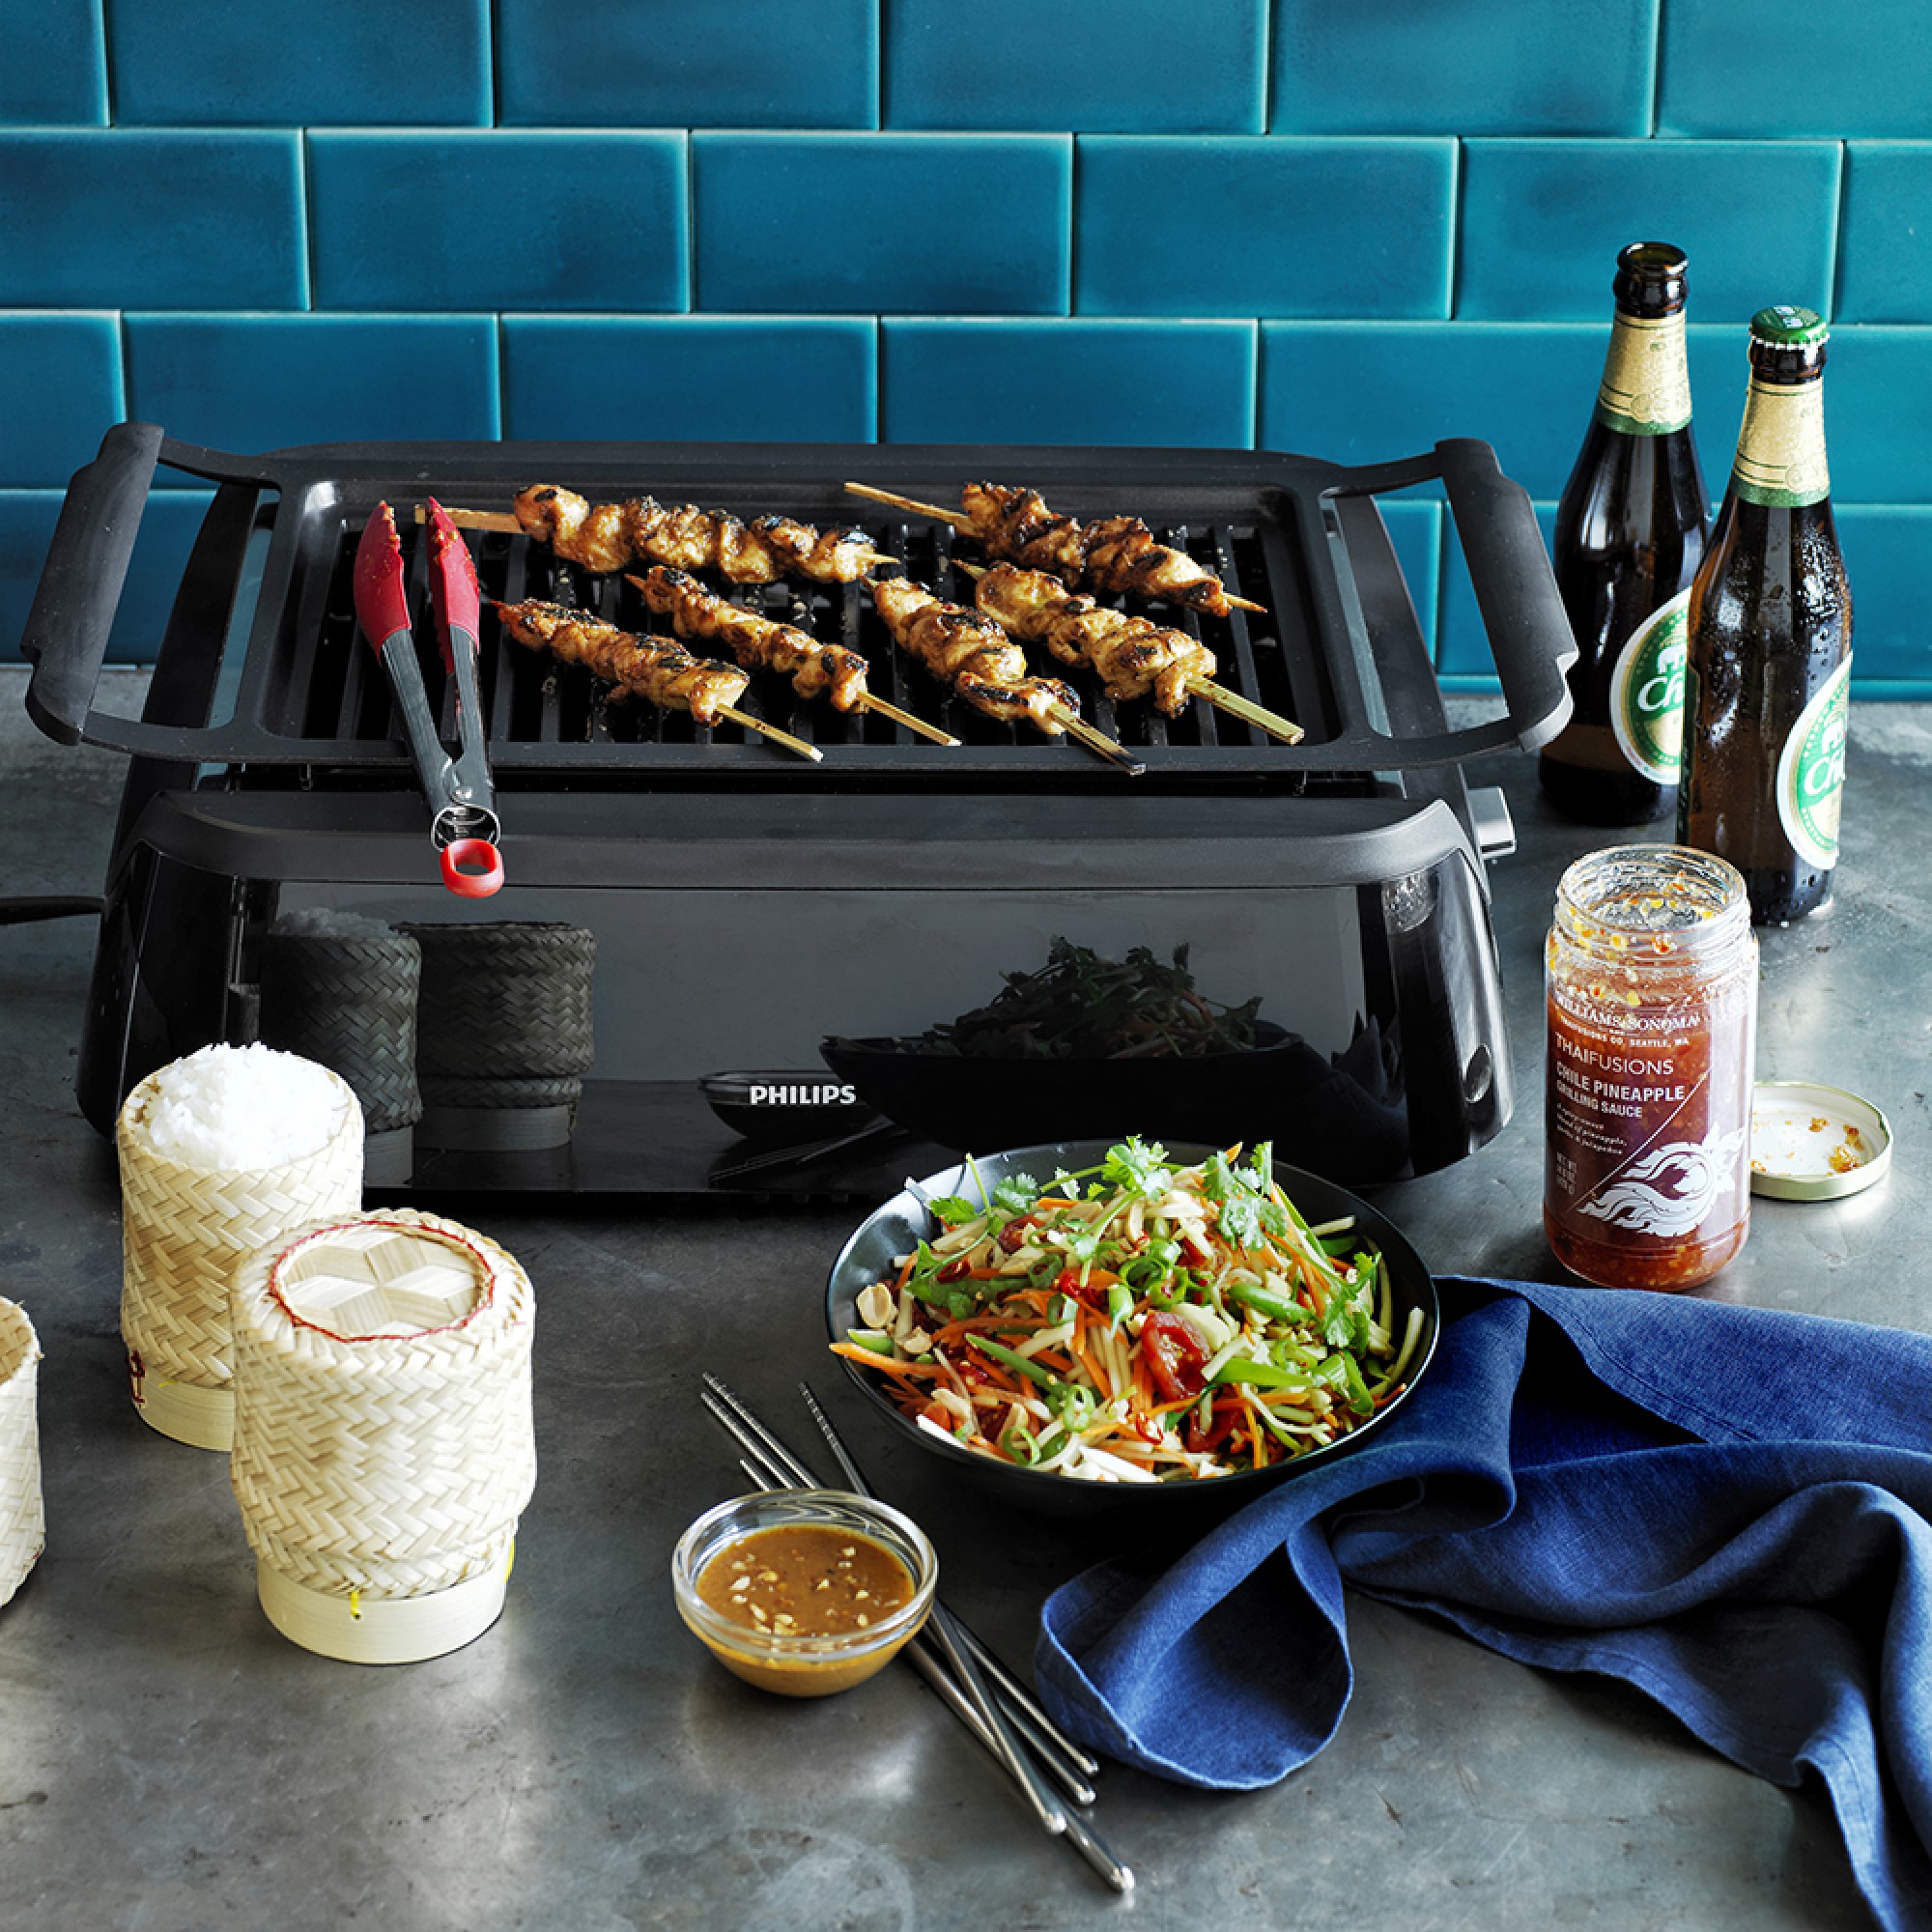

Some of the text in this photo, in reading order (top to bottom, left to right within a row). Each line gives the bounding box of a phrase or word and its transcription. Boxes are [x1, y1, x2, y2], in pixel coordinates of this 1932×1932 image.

[750, 1084, 857, 1105] PHILIPS
[1556, 1060, 1686, 1102] CHILE PINEAPPLE
[1556, 1079, 1599, 1111] GRILLING
[1601, 1100, 1643, 1119] SAUCE
